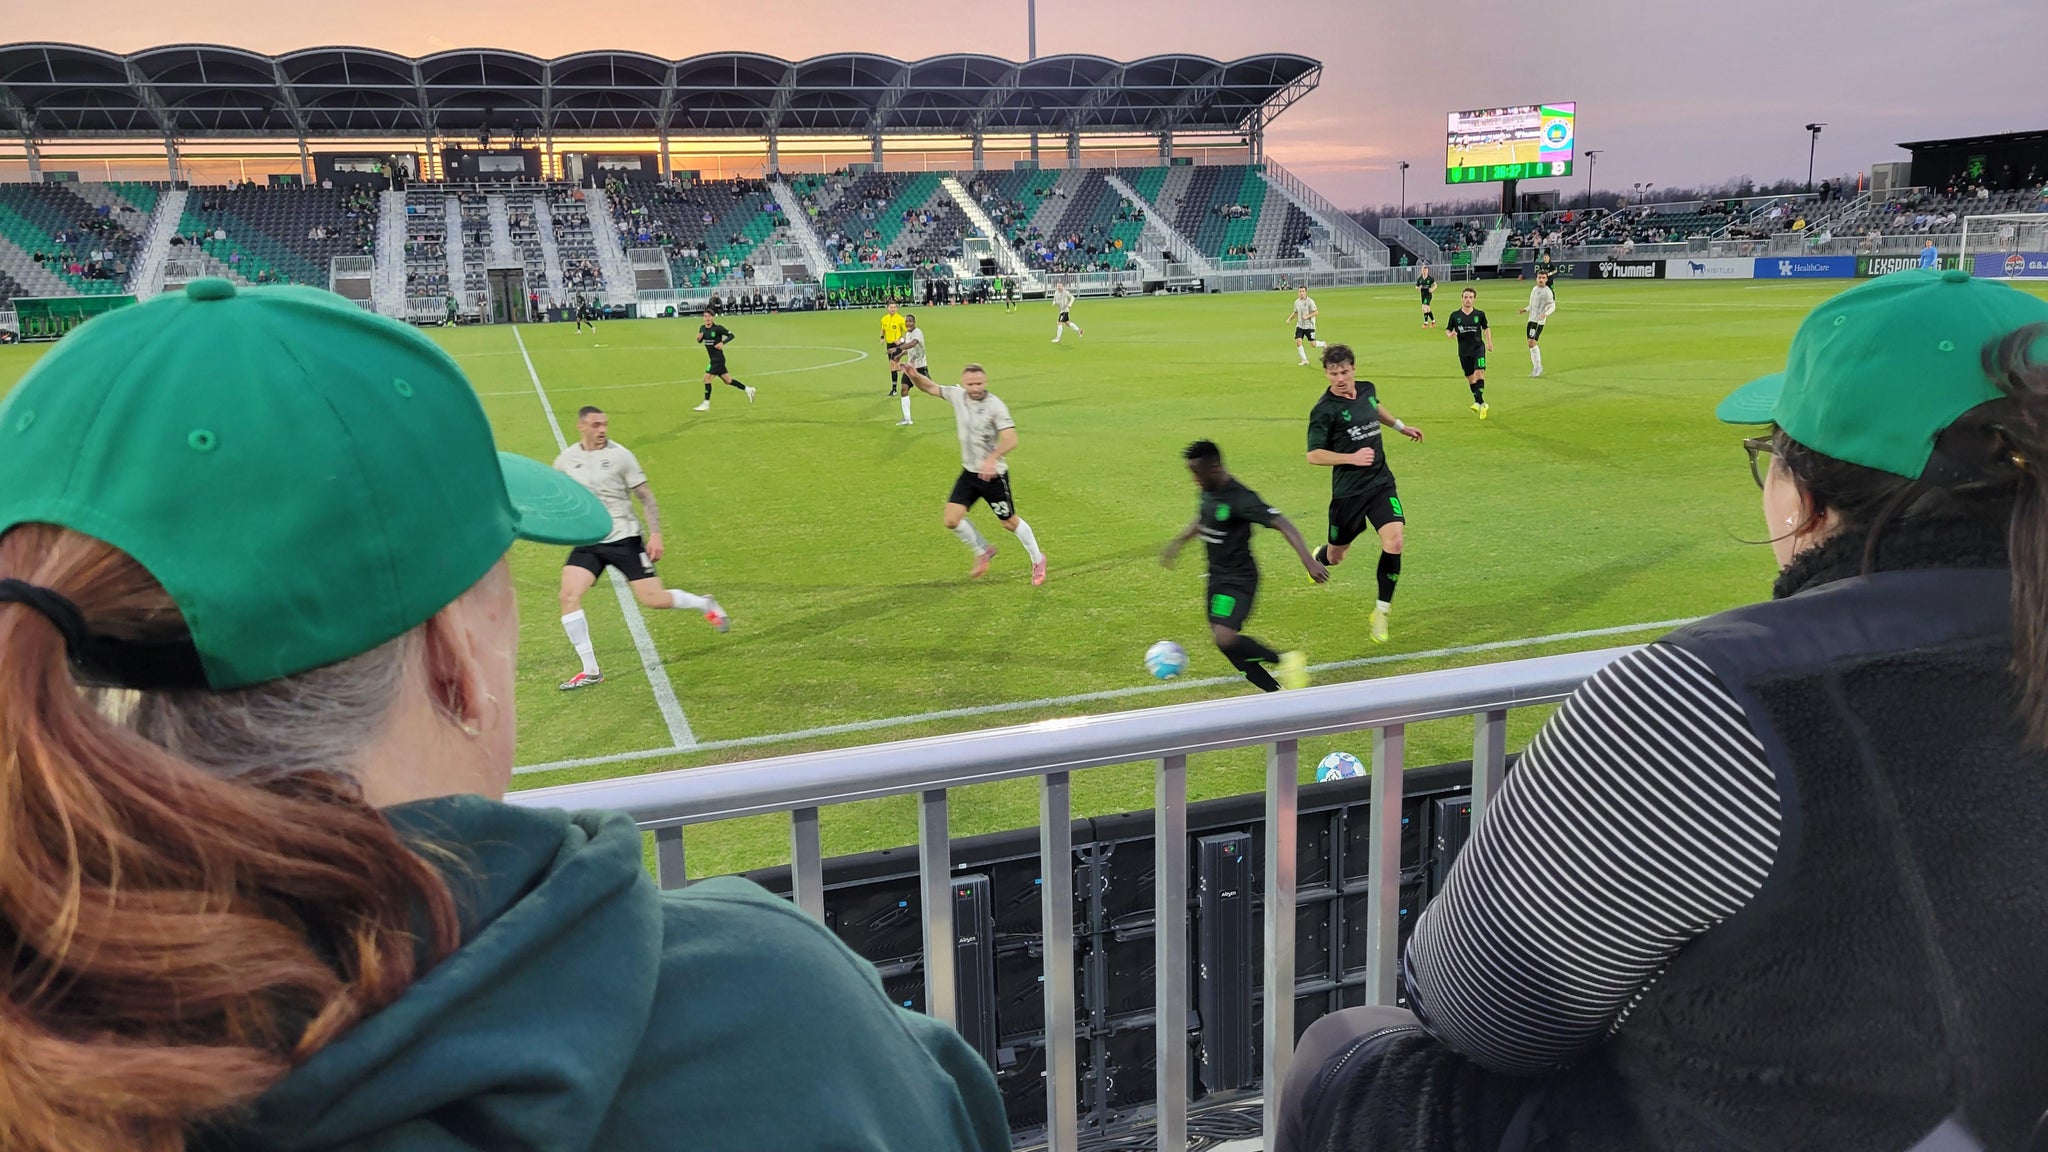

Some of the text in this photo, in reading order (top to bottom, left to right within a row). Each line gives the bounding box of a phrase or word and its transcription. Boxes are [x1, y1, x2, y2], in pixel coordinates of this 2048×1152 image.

[1534, 264, 1574, 273] POF
[1612, 262, 1656, 278] hummel
[1794, 264, 1830, 272] HealthCare
[990, 500, 1010, 517] 23
[1389, 496, 1403, 515] 9
